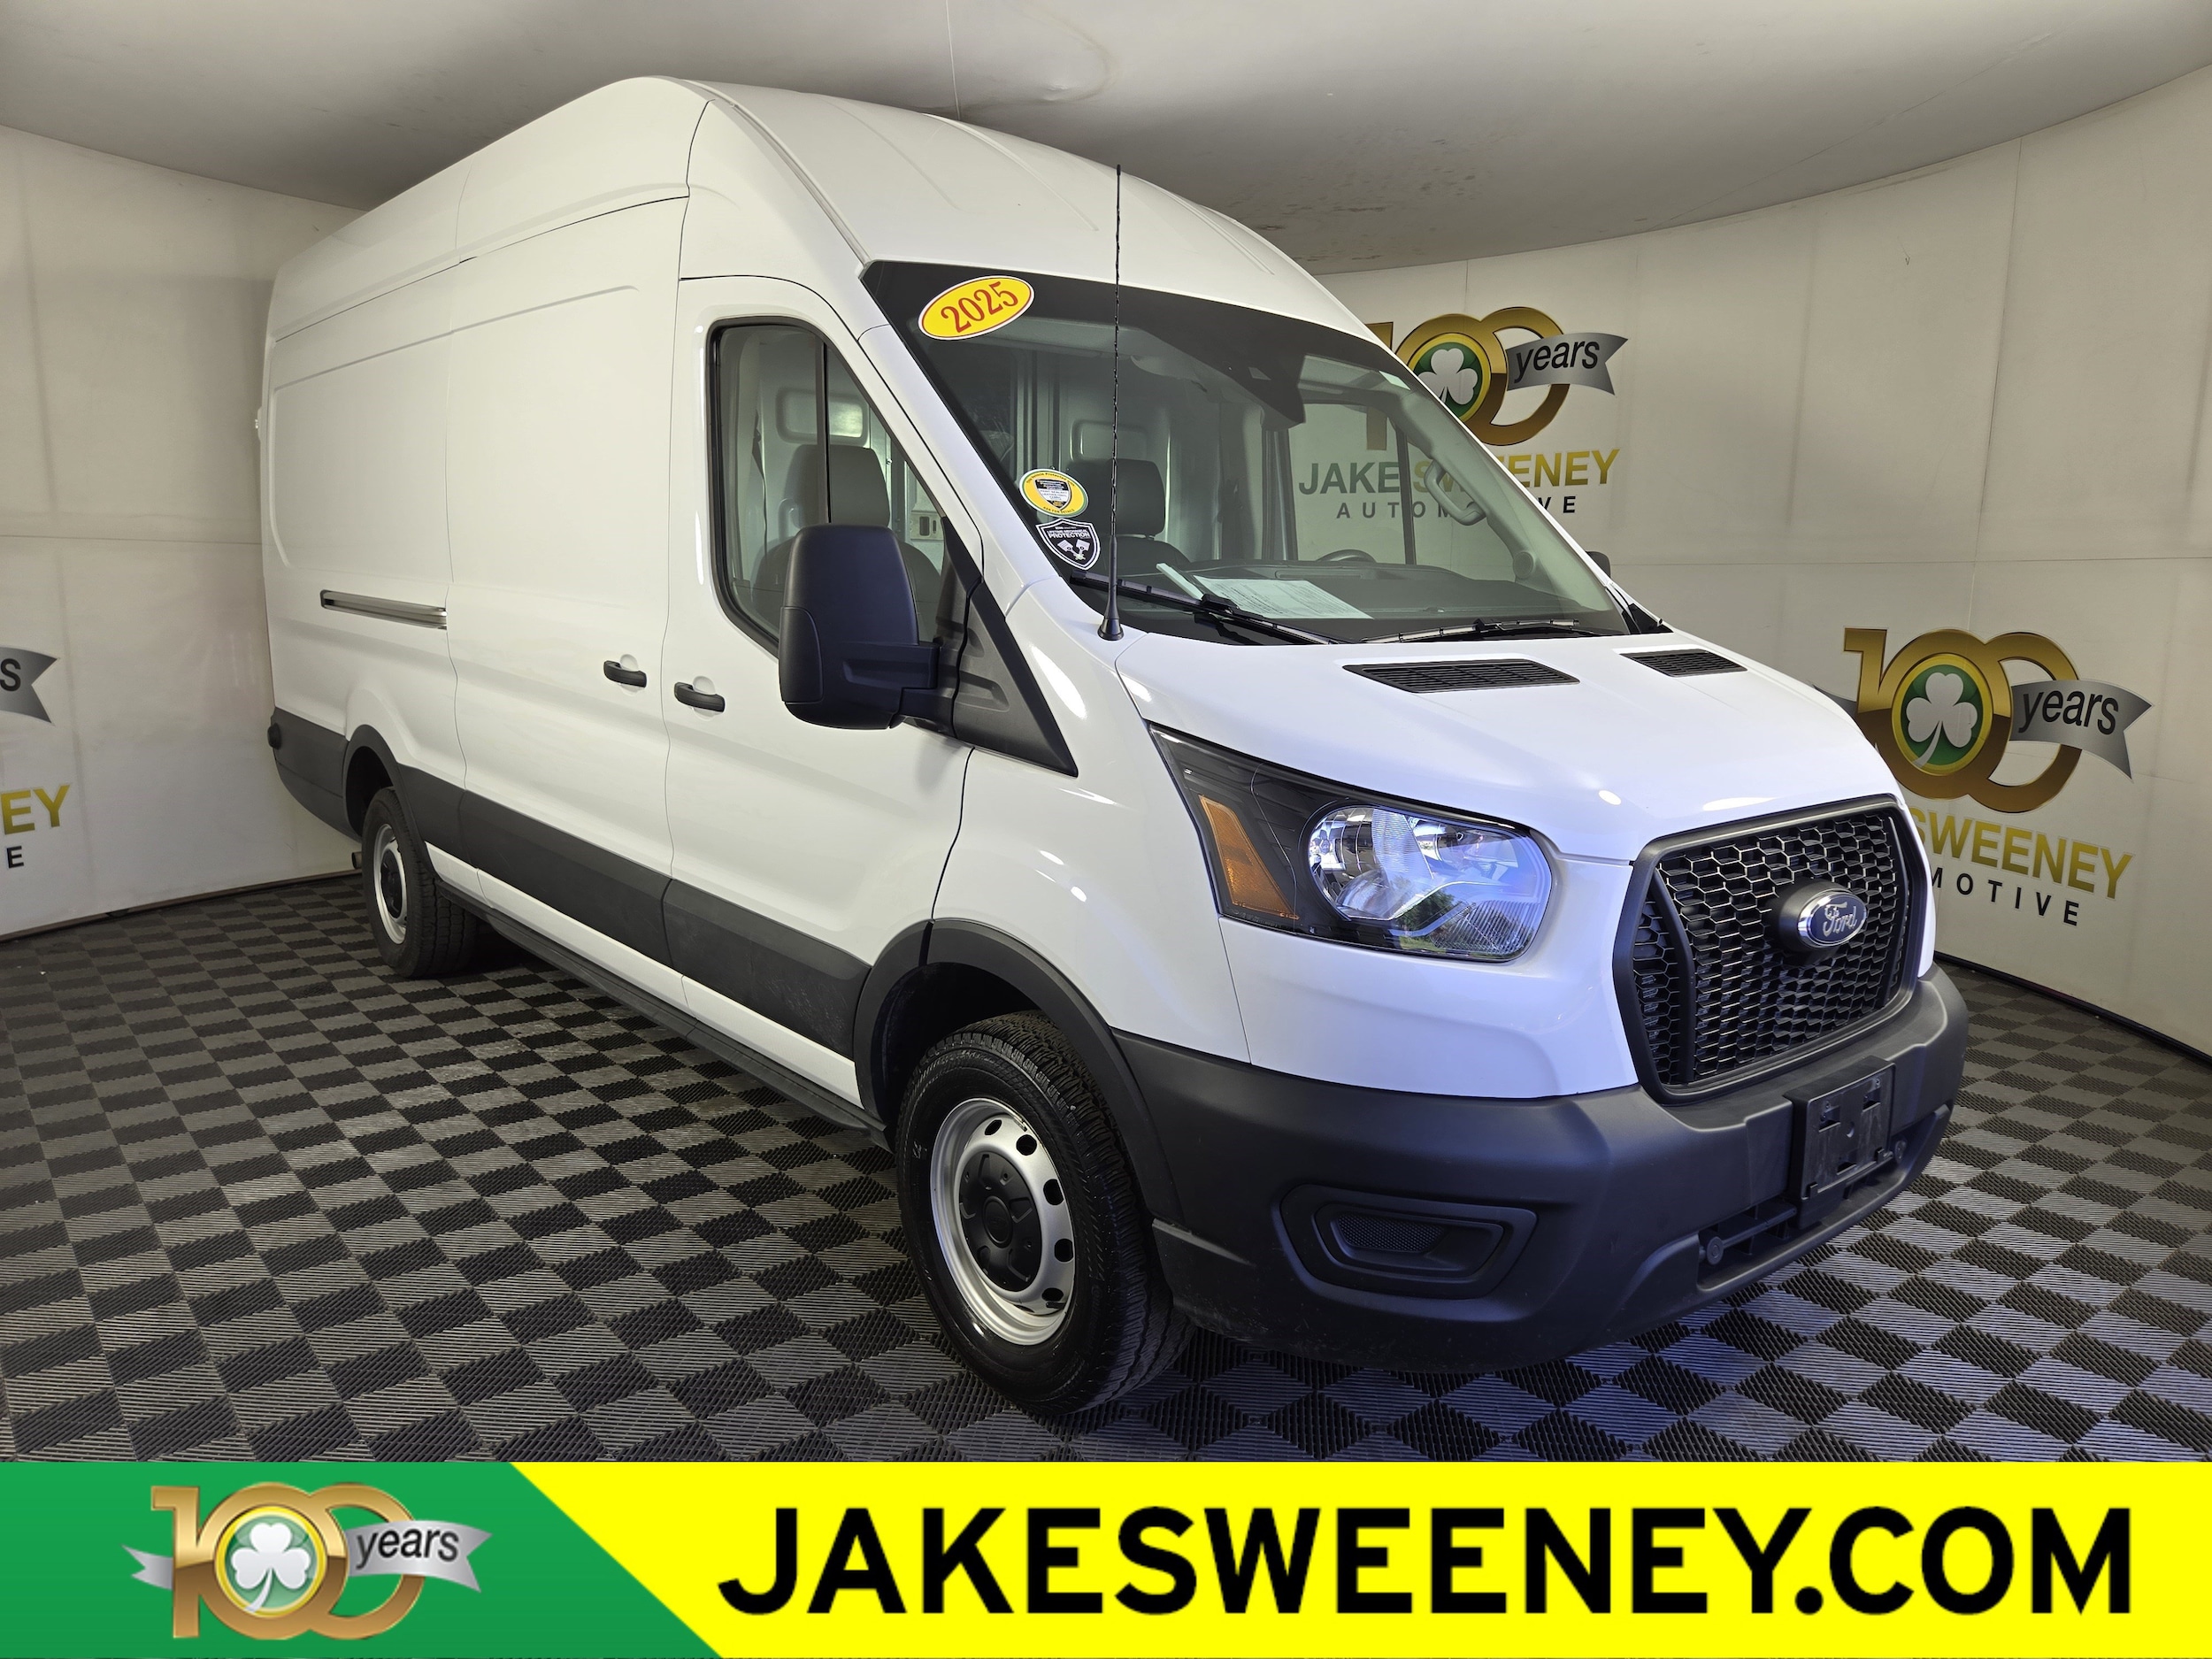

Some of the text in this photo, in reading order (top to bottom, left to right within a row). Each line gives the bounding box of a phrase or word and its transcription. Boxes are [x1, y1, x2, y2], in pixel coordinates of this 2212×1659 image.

[941, 280, 1018, 333] 2025
[1513, 340, 1601, 384] years
[1299, 461, 1400, 495] JAKE
[2018, 689, 2119, 736] years
[1823, 901, 1858, 937] Ford
